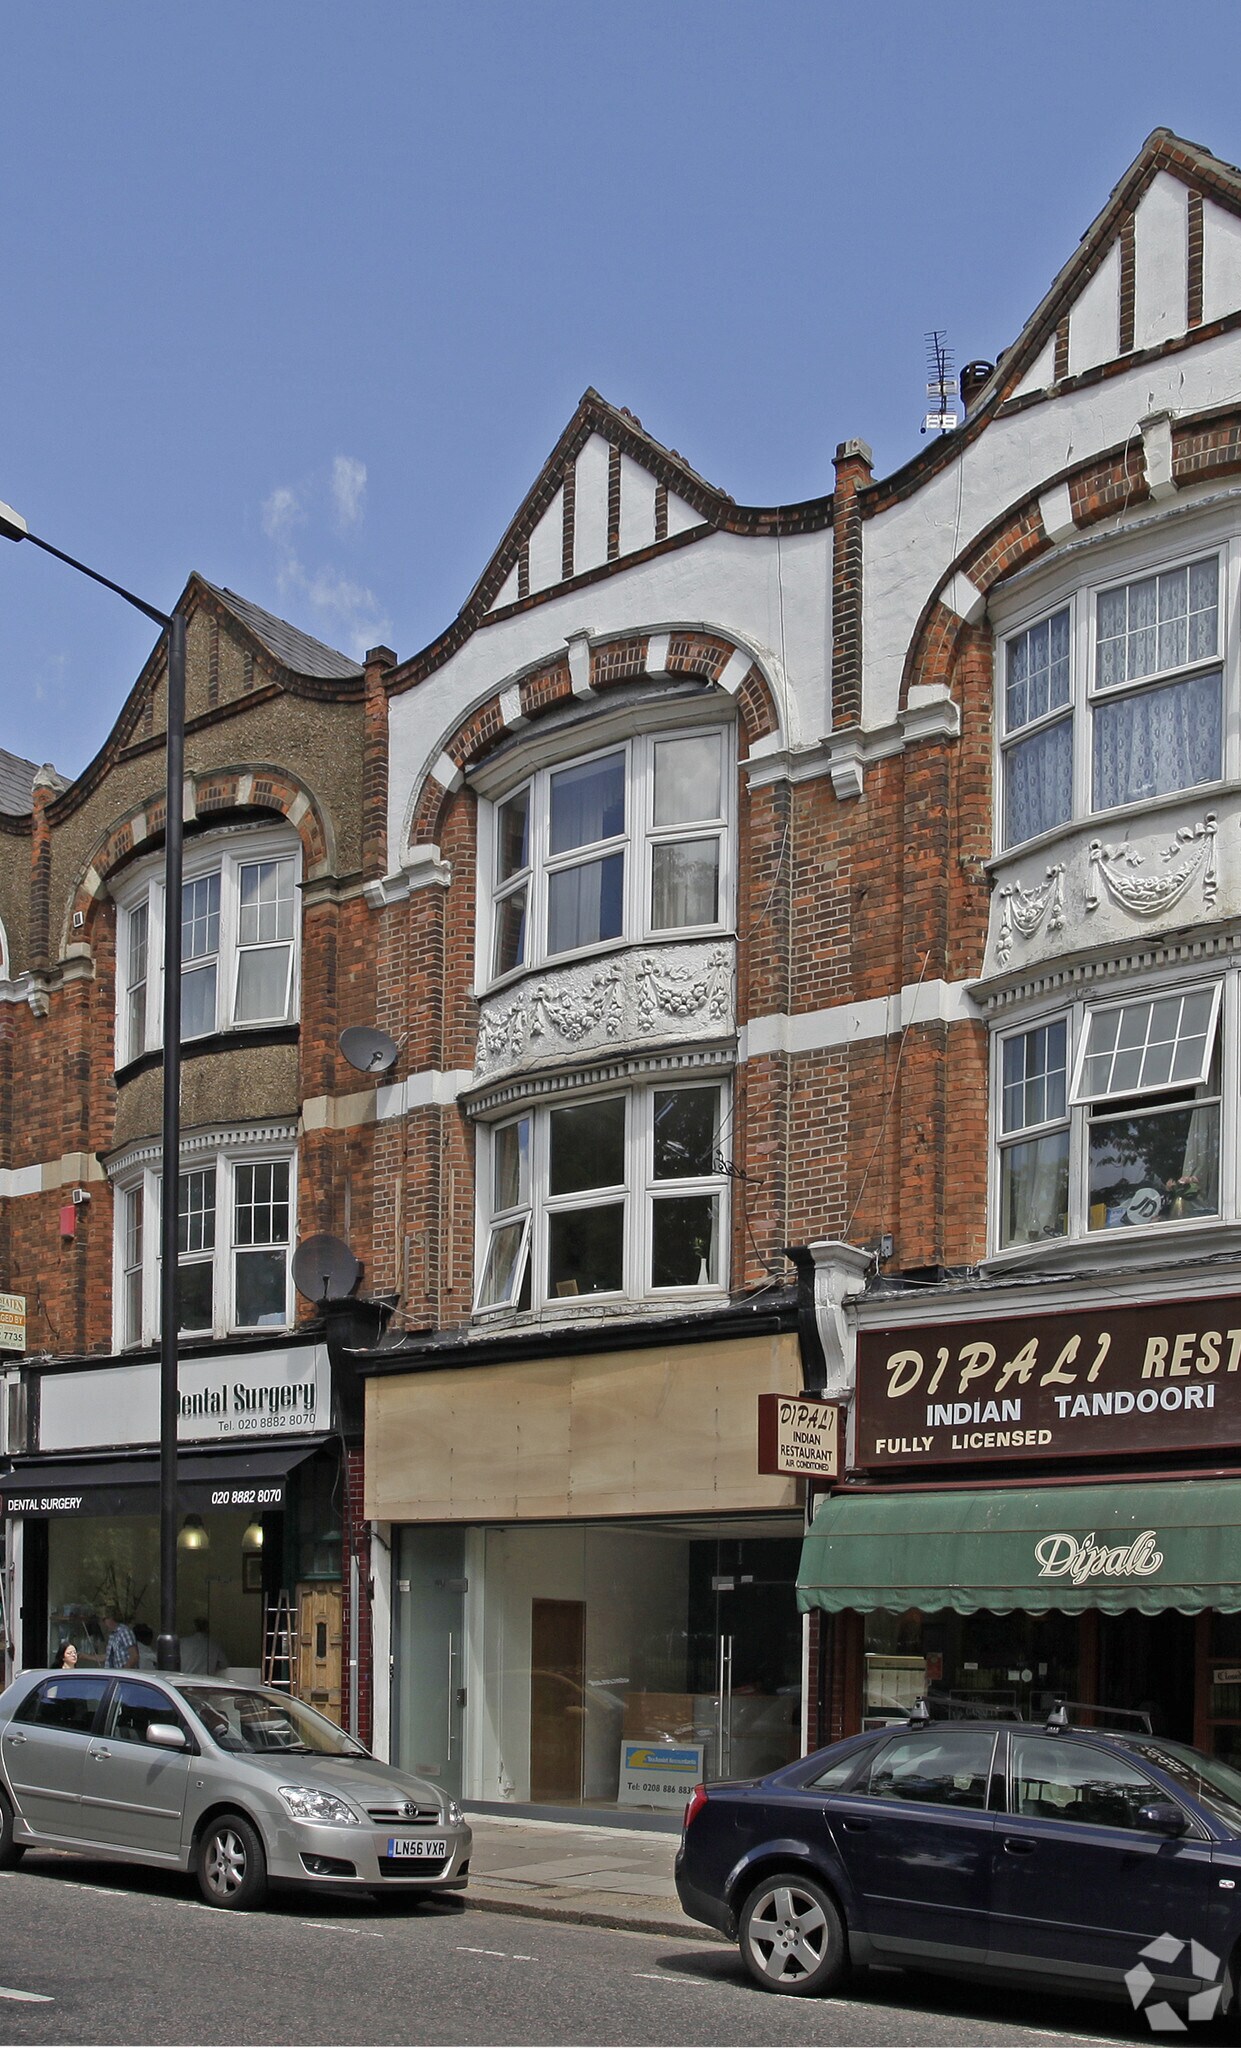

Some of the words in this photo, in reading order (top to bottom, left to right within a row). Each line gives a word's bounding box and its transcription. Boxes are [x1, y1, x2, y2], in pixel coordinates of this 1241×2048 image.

[3, 1331, 23, 1342] 7735
[886, 1332, 1112, 1398] DIPALI
[177, 1384, 228, 1415] ental
[233, 1383, 315, 1413] Surgery
[926, 1398, 1021, 1427] INDIAN
[1054, 1384, 1215, 1418] TANDOORI
[218, 1421, 235, 1432] Tel.
[238, 1418, 258, 1430] 020
[260, 1416, 286, 1428] 8882
[289, 1413, 316, 1425] 8070
[780, 1403, 834, 1431] DIPALI
[793, 1431, 821, 1445] INDIAN
[875, 1436, 934, 1454] FULLY
[952, 1429, 1052, 1450] LICENSED
[780, 1444, 833, 1461] RESTAURANT
[785, 1459, 795, 1468] AIR
[795, 1460, 829, 1472] CONDITIONED
[8, 1499, 39, 1511] DENTAL
[40, 1497, 82, 1510] SURGERY
[211, 1491, 230, 1504] 020
[231, 1490, 256, 1504] 8882
[257, 1489, 282, 1503] 8070
[1034, 1530, 1164, 1585] Dipali
[627, 1782, 640, 1791] Tel:
[643, 1783, 660, 1792] 0208
[663, 1784, 676, 1793] 886
[395, 1841, 424, 1855] LN56
[426, 1841, 445, 1856] VXR
